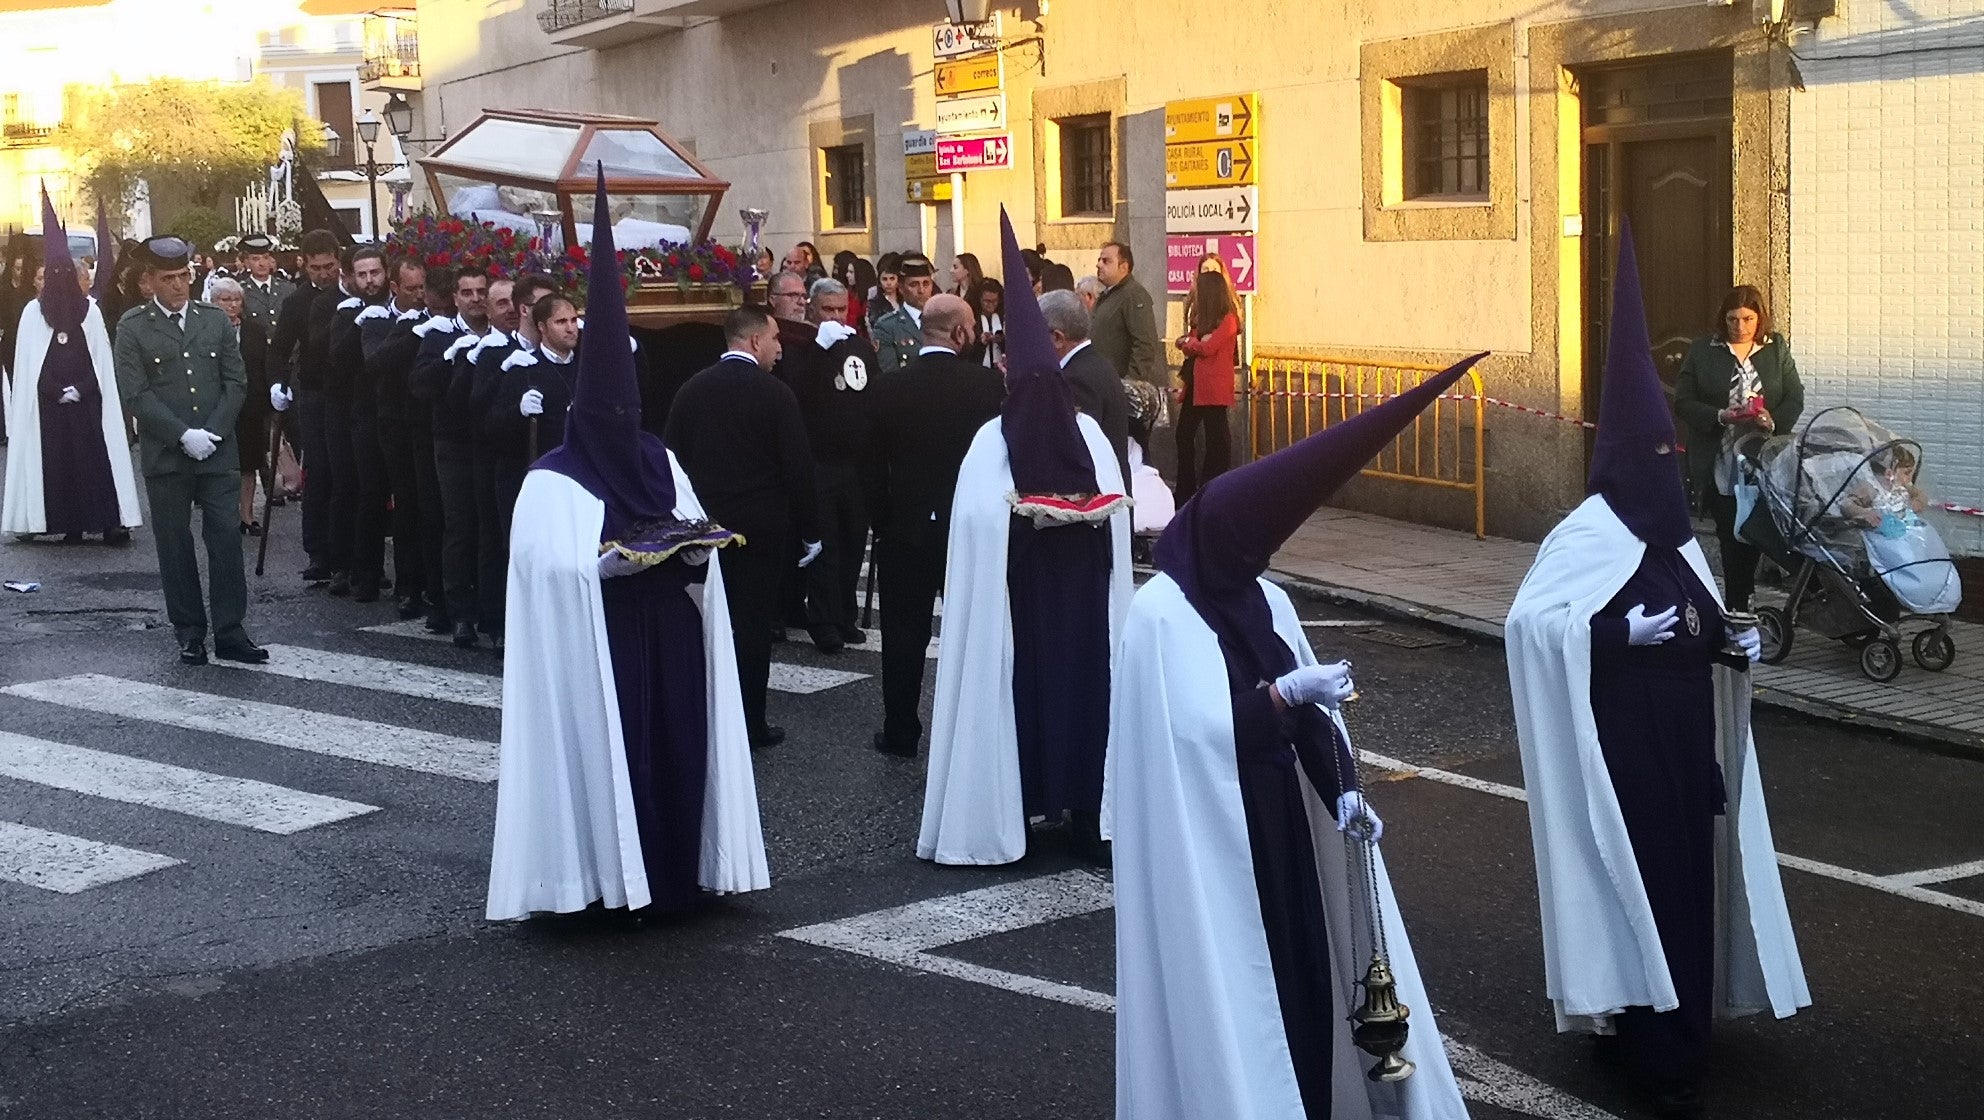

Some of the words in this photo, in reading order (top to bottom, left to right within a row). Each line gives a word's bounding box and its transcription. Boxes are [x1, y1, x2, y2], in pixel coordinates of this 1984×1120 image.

[973, 68, 997, 80] correos
[1166, 111, 1210, 125] AYUNTAMIENTO
[905, 135, 927, 151] guardia
[1166, 147, 1182, 160] CASA
[1183, 146, 1204, 159] RURAL
[939, 156, 951, 166] San
[1166, 161, 1178, 174] LOS
[1179, 159, 1209, 172] GAITANES
[1167, 202, 1196, 219] POLICÍA
[1198, 203, 1223, 218] LOCAL
[1167, 244, 1204, 257] BIBLIOTECA
[1168, 269, 1185, 283] CASA
[1185, 269, 1195, 283] DE
